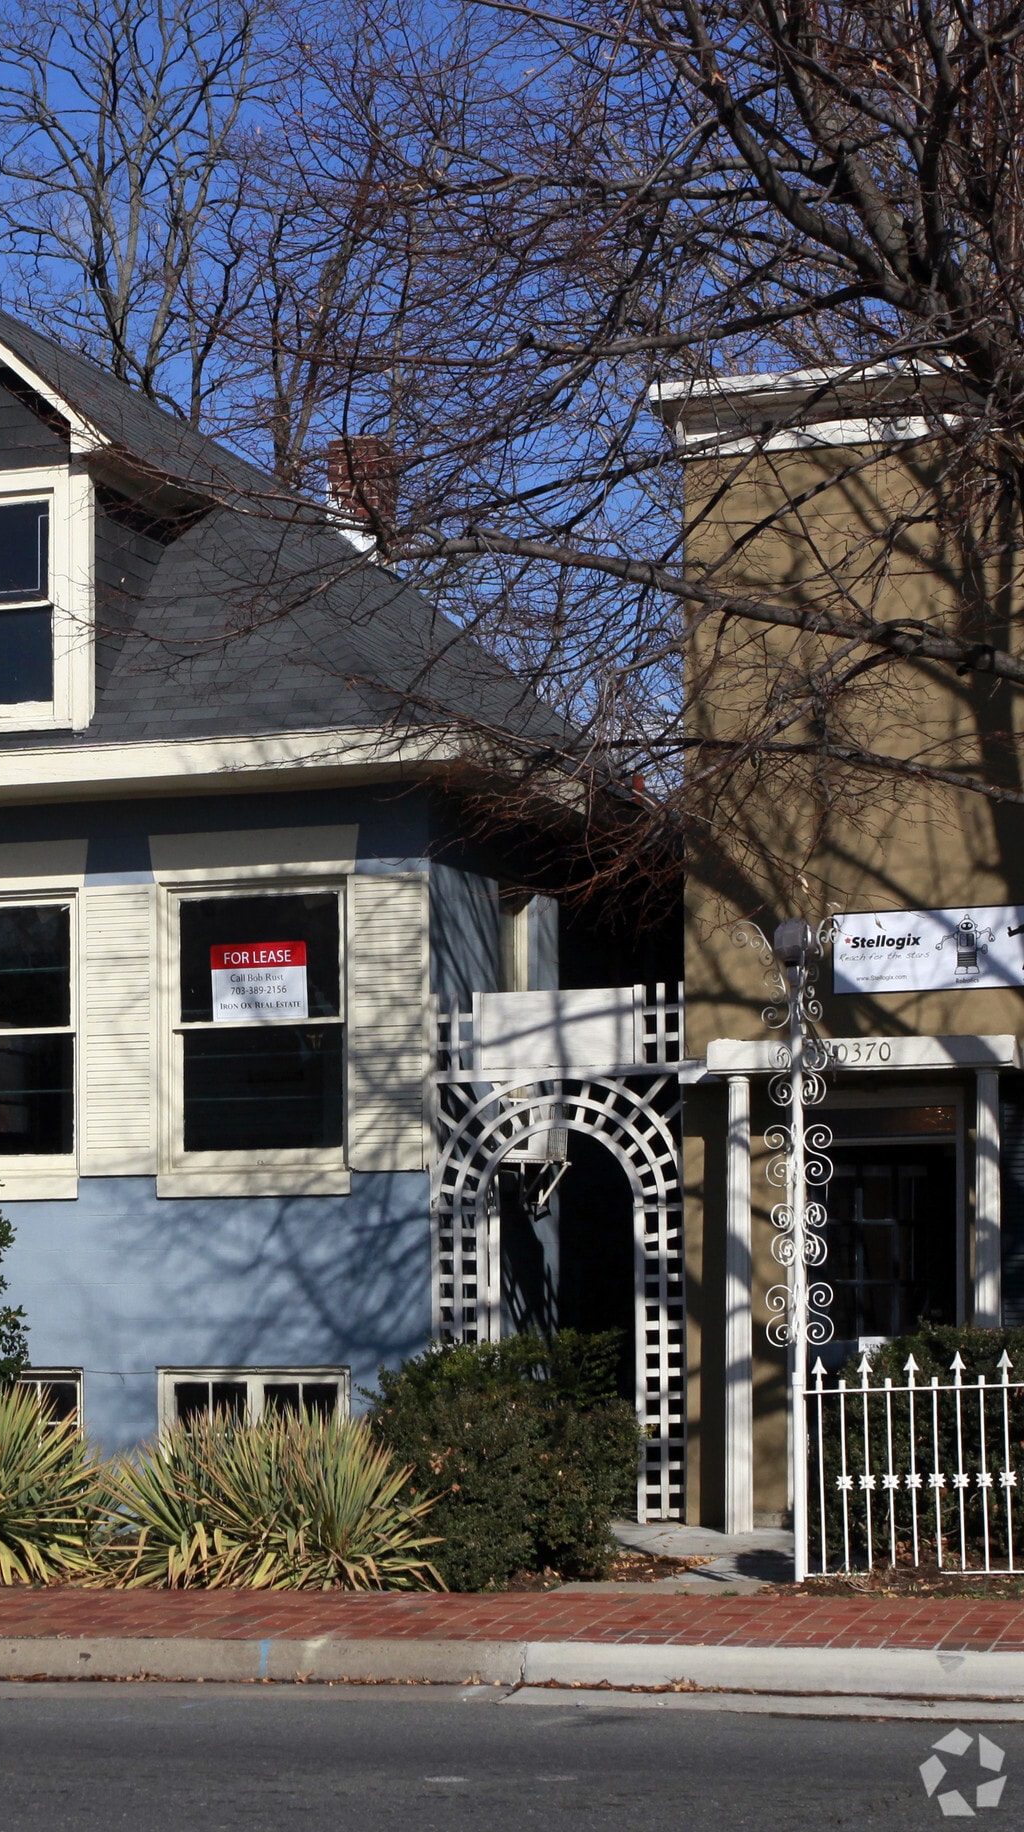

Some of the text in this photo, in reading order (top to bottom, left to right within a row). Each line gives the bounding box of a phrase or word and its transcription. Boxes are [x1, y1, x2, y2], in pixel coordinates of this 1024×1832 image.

[851, 933, 921, 950] Stellogix
[223, 950, 292, 964] FOR LEASE
[839, 951, 930, 962] Reach for the stars
[230, 972, 284, 983] Call Bob Rust
[231, 985, 287, 995] 703-389-2156
